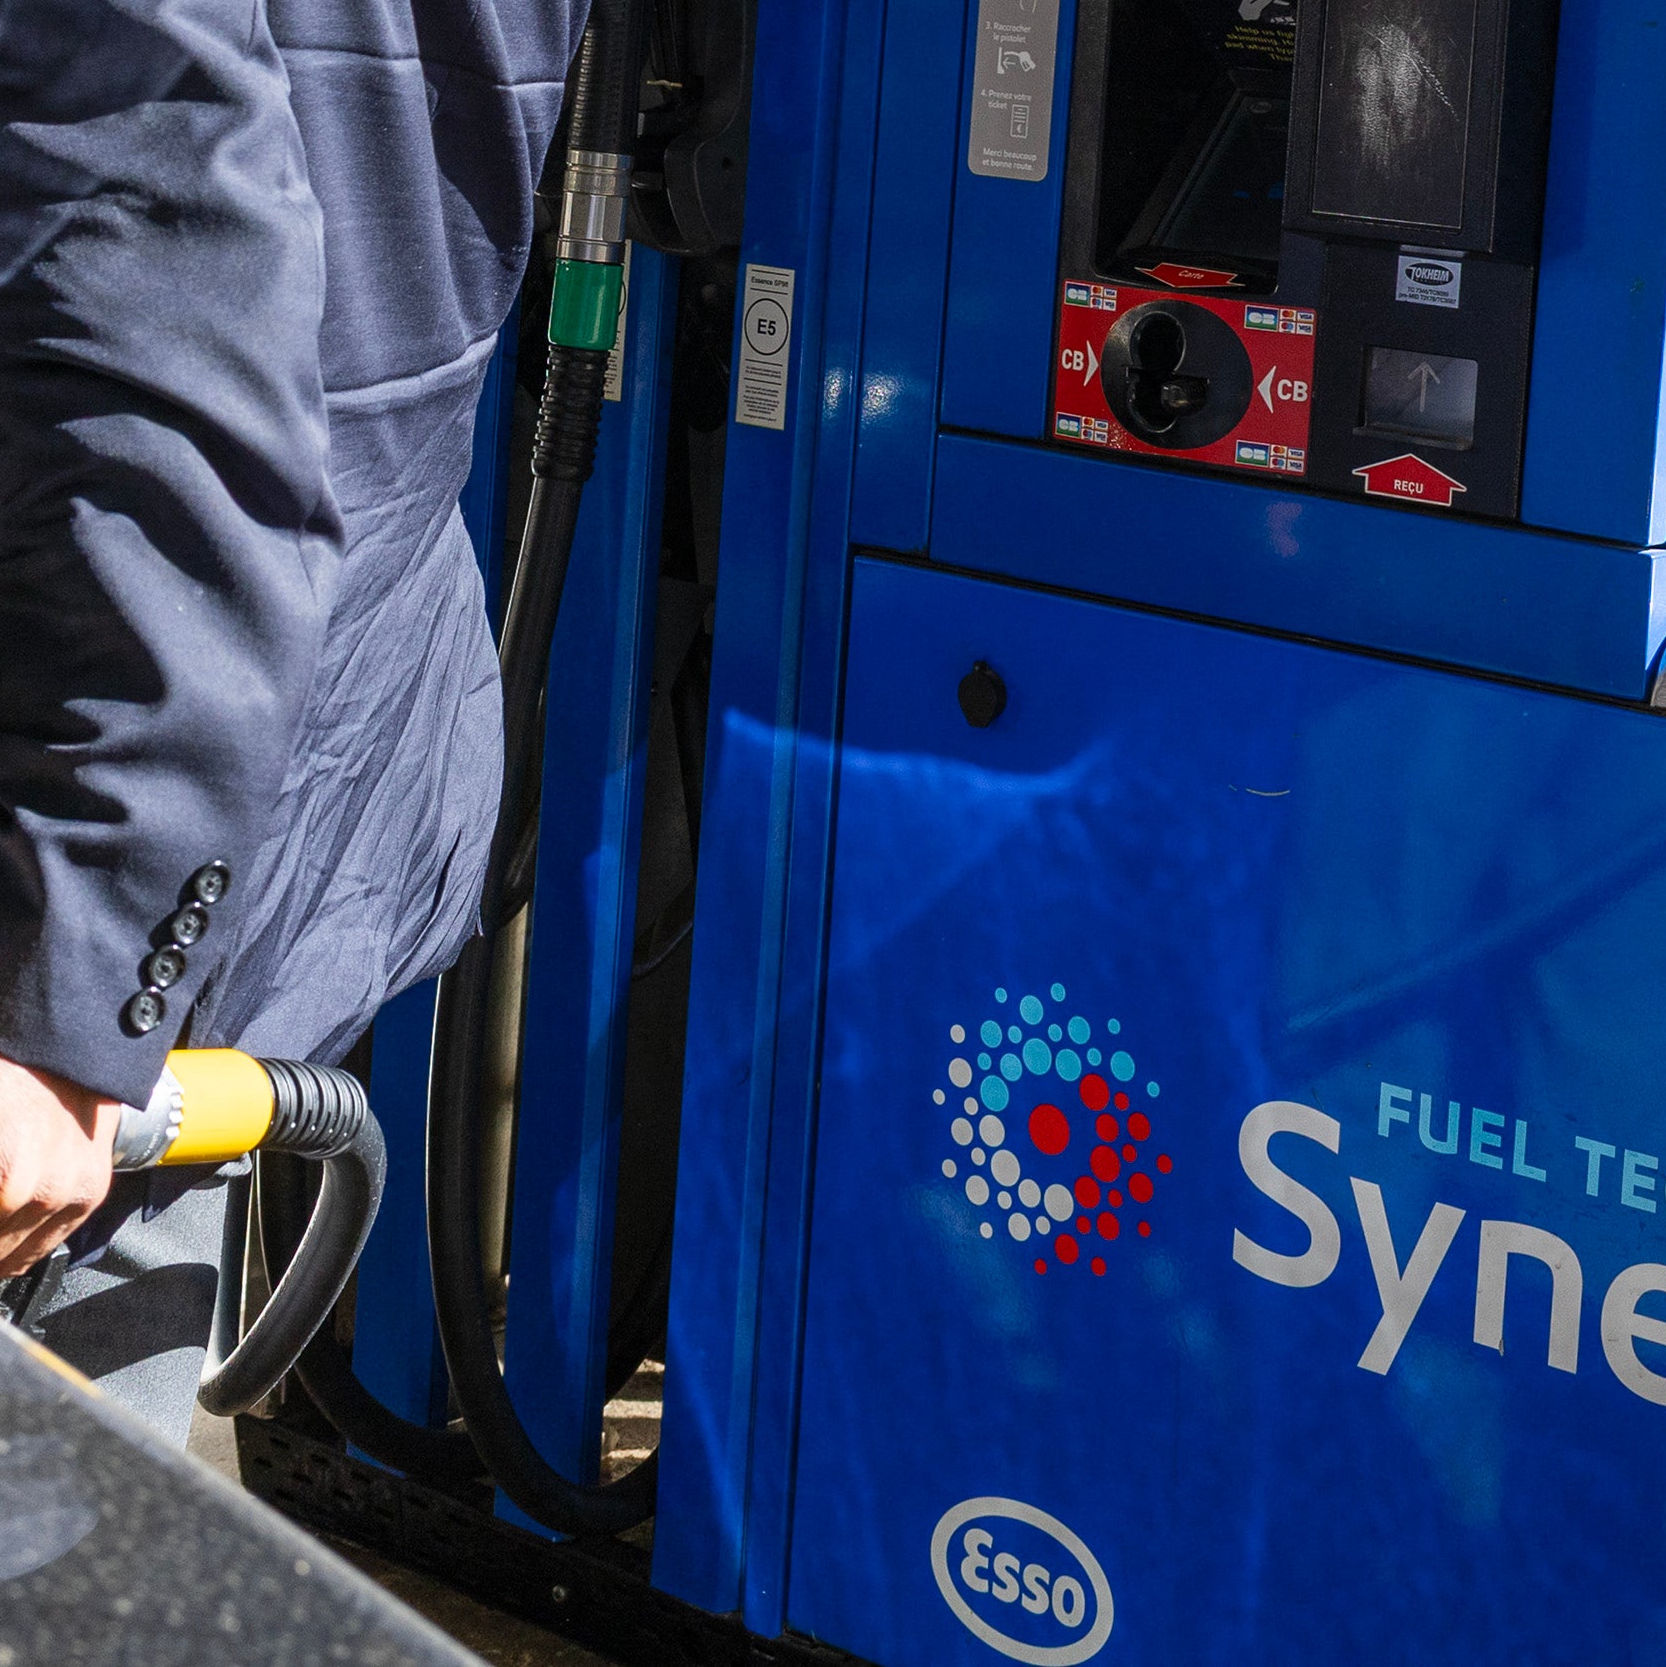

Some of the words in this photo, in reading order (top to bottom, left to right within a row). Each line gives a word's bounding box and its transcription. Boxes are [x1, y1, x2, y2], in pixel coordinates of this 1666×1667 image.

[993, 22, 1032, 33] Raccrocher
[993, 33, 1000, 42] le
[1000, 34, 1027, 44] pistolet
[988, 89, 1013, 99] Prenez
[1013, 94, 1032, 102] votre
[988, 100, 1008, 110] ticket
[983, 147, 1002, 157] Merci
[1002, 150, 1038, 162] beaucoup
[982, 158, 991, 167] et
[990, 158, 1013, 168] bonne
[1178, 269, 1205, 280] Carte
[1406, 266, 1449, 282] TOKHEIM
[751, 276, 773, 286] Essence
[1298, 313, 1313, 321] VISA
[757, 319, 776, 335] E5
[1061, 348, 1084, 371] CB
[1277, 379, 1308, 402] CB
[1289, 450, 1304, 458] VISA
[1393, 479, 1424, 495] REÇU
[1375, 1082, 1548, 1181] FUEL
[960, 1528, 1087, 1629] Esso
